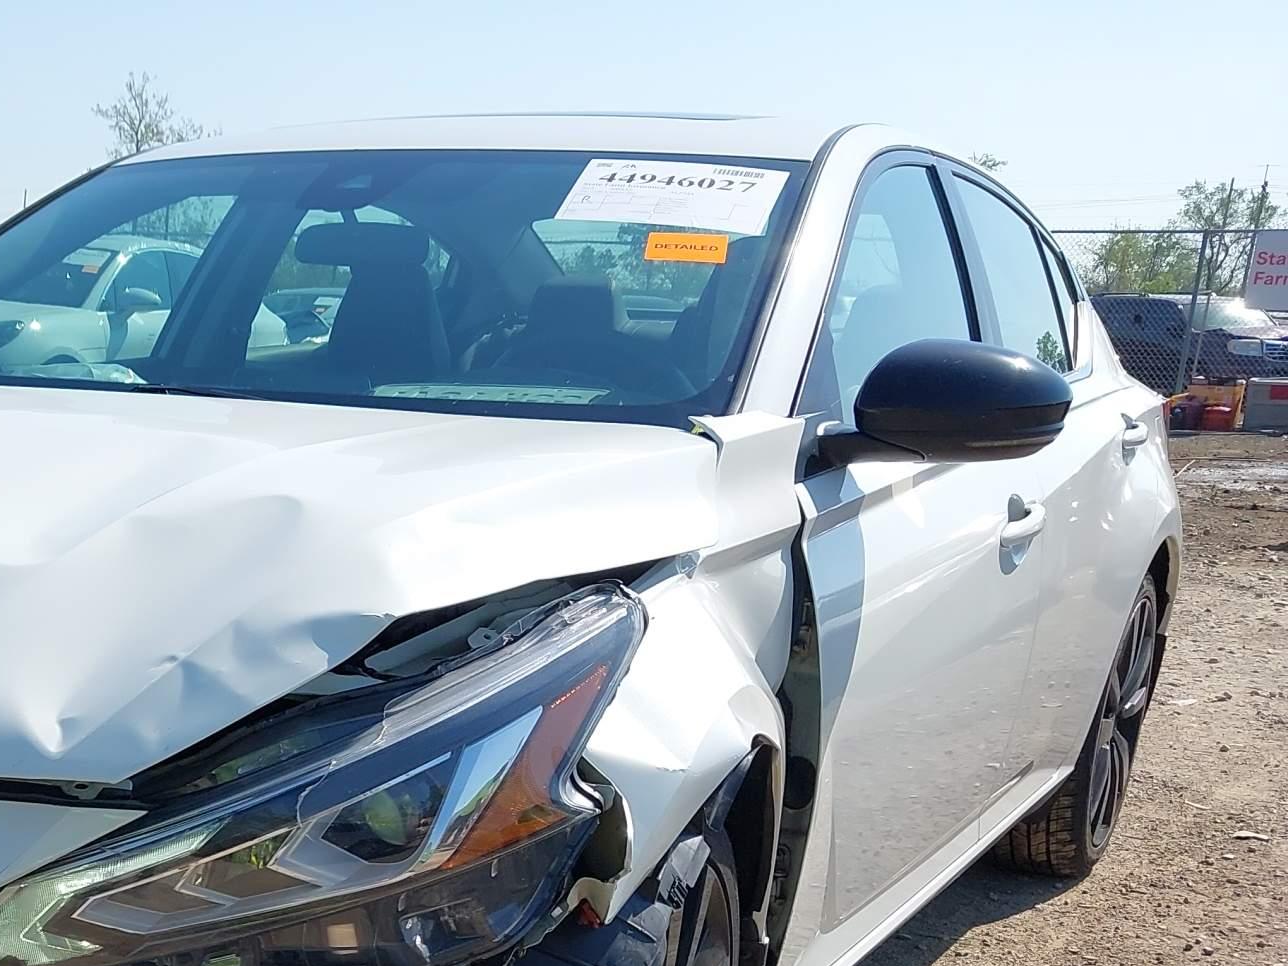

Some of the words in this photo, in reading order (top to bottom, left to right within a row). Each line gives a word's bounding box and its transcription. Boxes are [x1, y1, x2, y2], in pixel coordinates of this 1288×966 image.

[598, 171, 758, 193] 44946027
[654, 242, 719, 252] DETAILED
[1256, 251, 1288, 266] Sta
